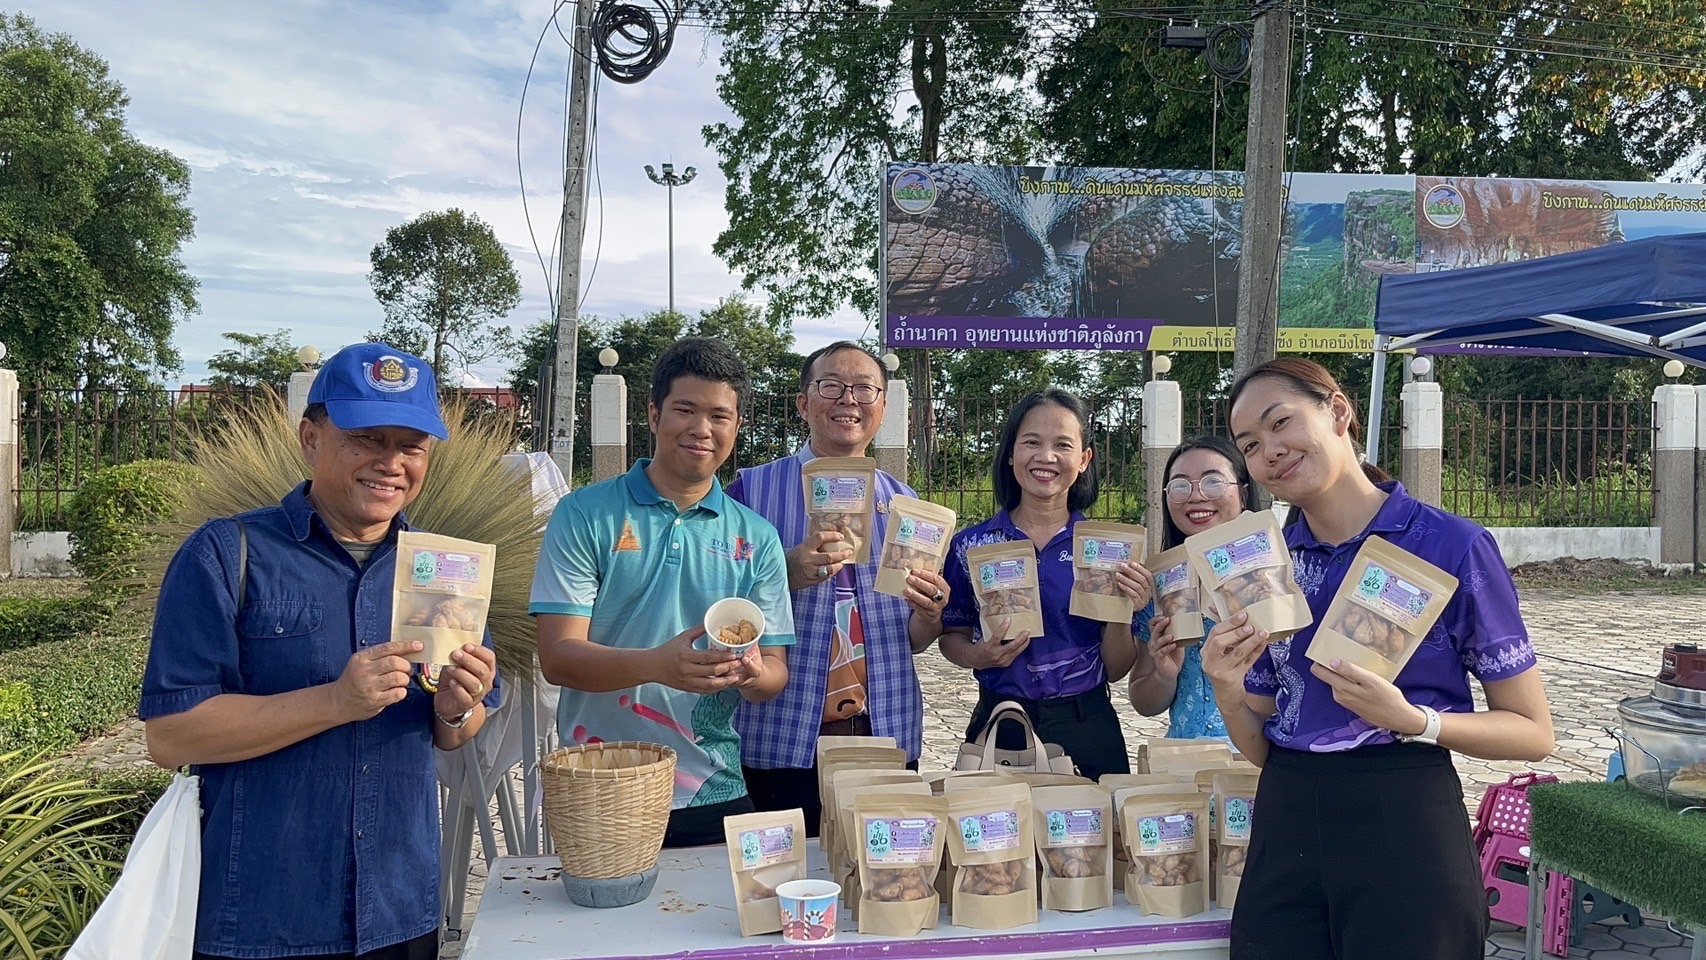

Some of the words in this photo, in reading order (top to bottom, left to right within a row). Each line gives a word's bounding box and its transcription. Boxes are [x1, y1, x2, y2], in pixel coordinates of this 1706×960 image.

[893, 315, 957, 341] ถ้ำนาคา
[965, 322, 1144, 348] อุทยานแห่งชาติภูลังกา
[1299, 333, 1375, 349] อำเภอบึงโขง
[711, 538, 724, 548] TO
